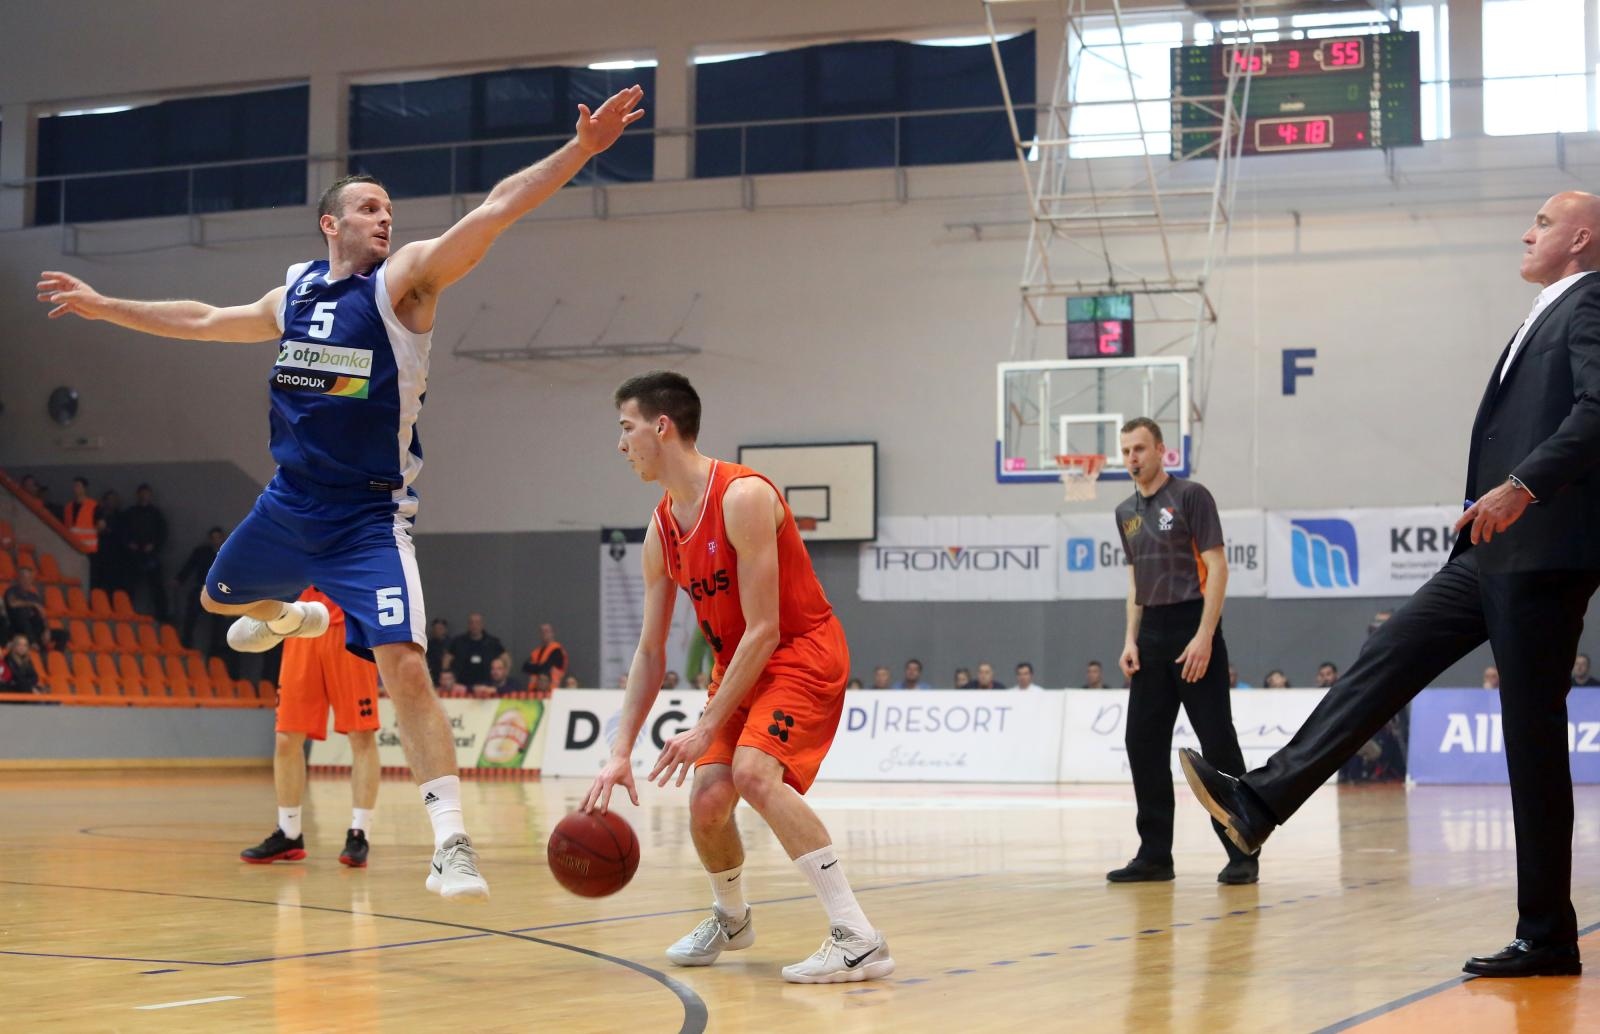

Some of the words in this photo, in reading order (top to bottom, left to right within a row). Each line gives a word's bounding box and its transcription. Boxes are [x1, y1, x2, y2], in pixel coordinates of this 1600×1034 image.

[1288, 50, 1301, 69] 3
[1331, 41, 1359, 66] 55
[1278, 121, 1326, 145] 4:18
[308, 301, 338, 339] 5
[1099, 321, 1122, 354] 2
[276, 373, 326, 389] CRODUX
[1282, 348, 1317, 396] F
[868, 545, 1051, 572] TROMONT
[376, 586, 405, 627] 5
